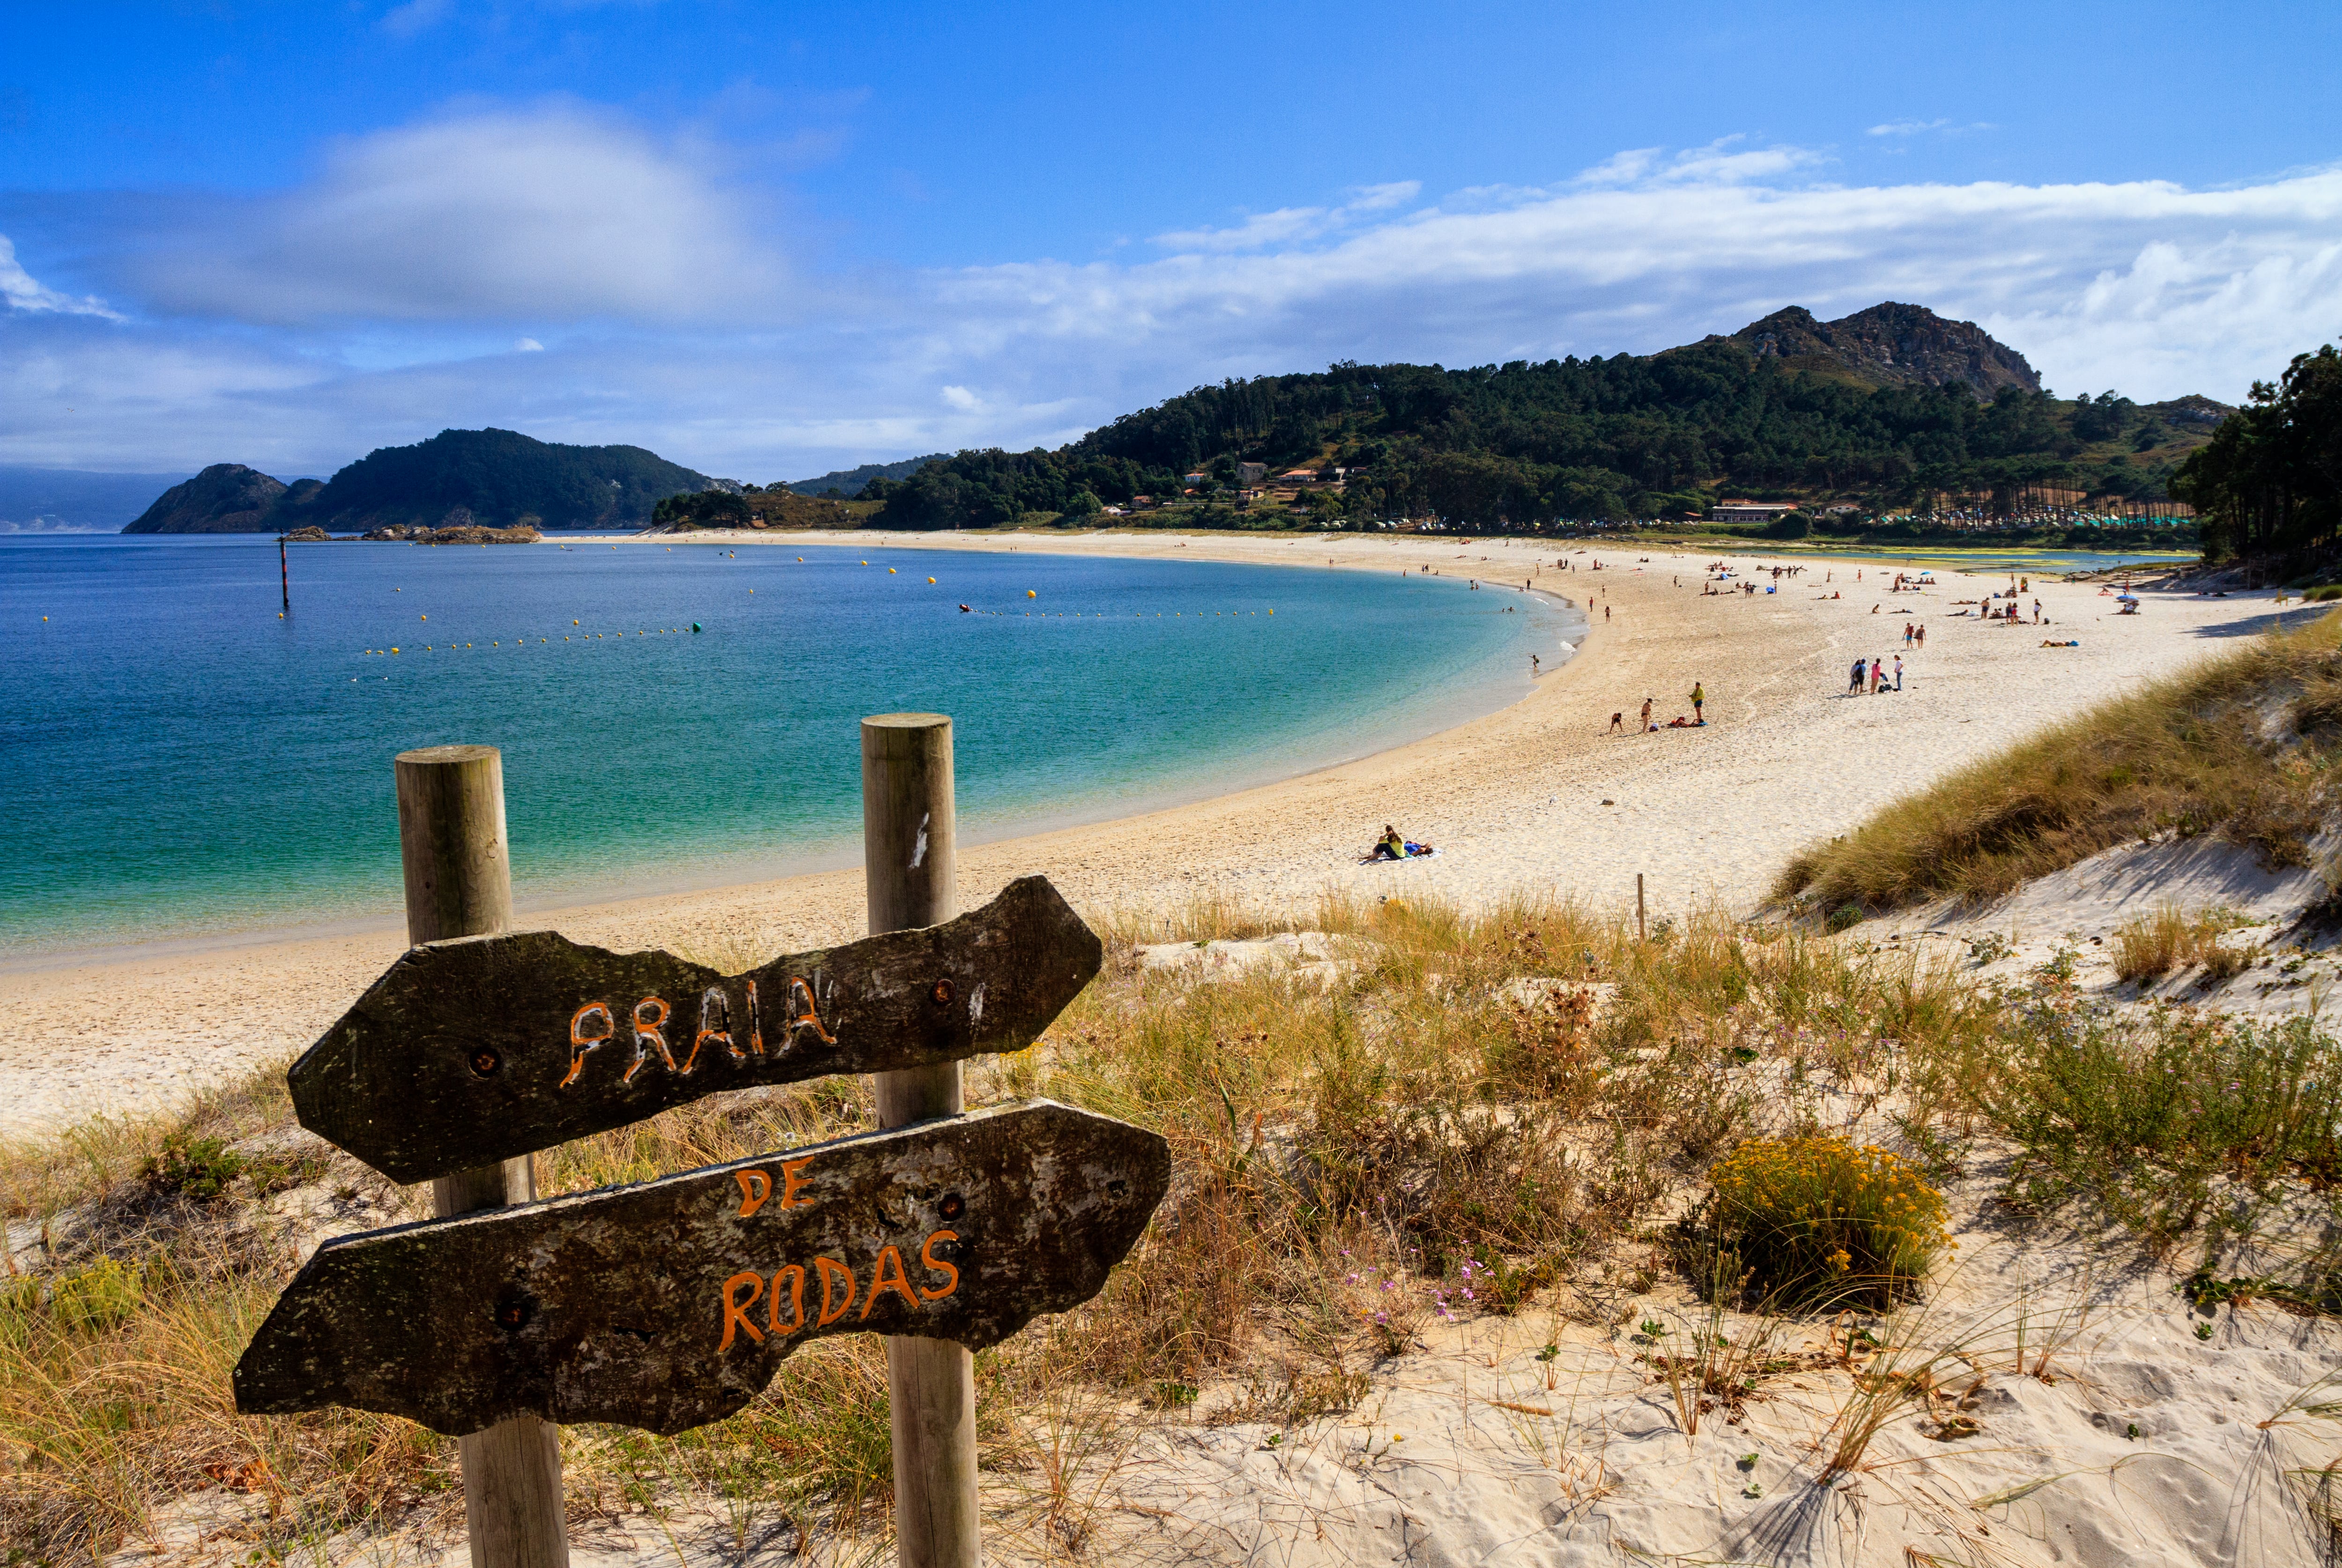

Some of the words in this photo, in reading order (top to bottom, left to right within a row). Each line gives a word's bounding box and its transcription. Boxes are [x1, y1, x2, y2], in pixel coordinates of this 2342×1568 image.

[560, 976, 837, 1088] PRAIA
[735, 1156, 815, 1218] DE
[718, 1230, 959, 1353] RODAS
